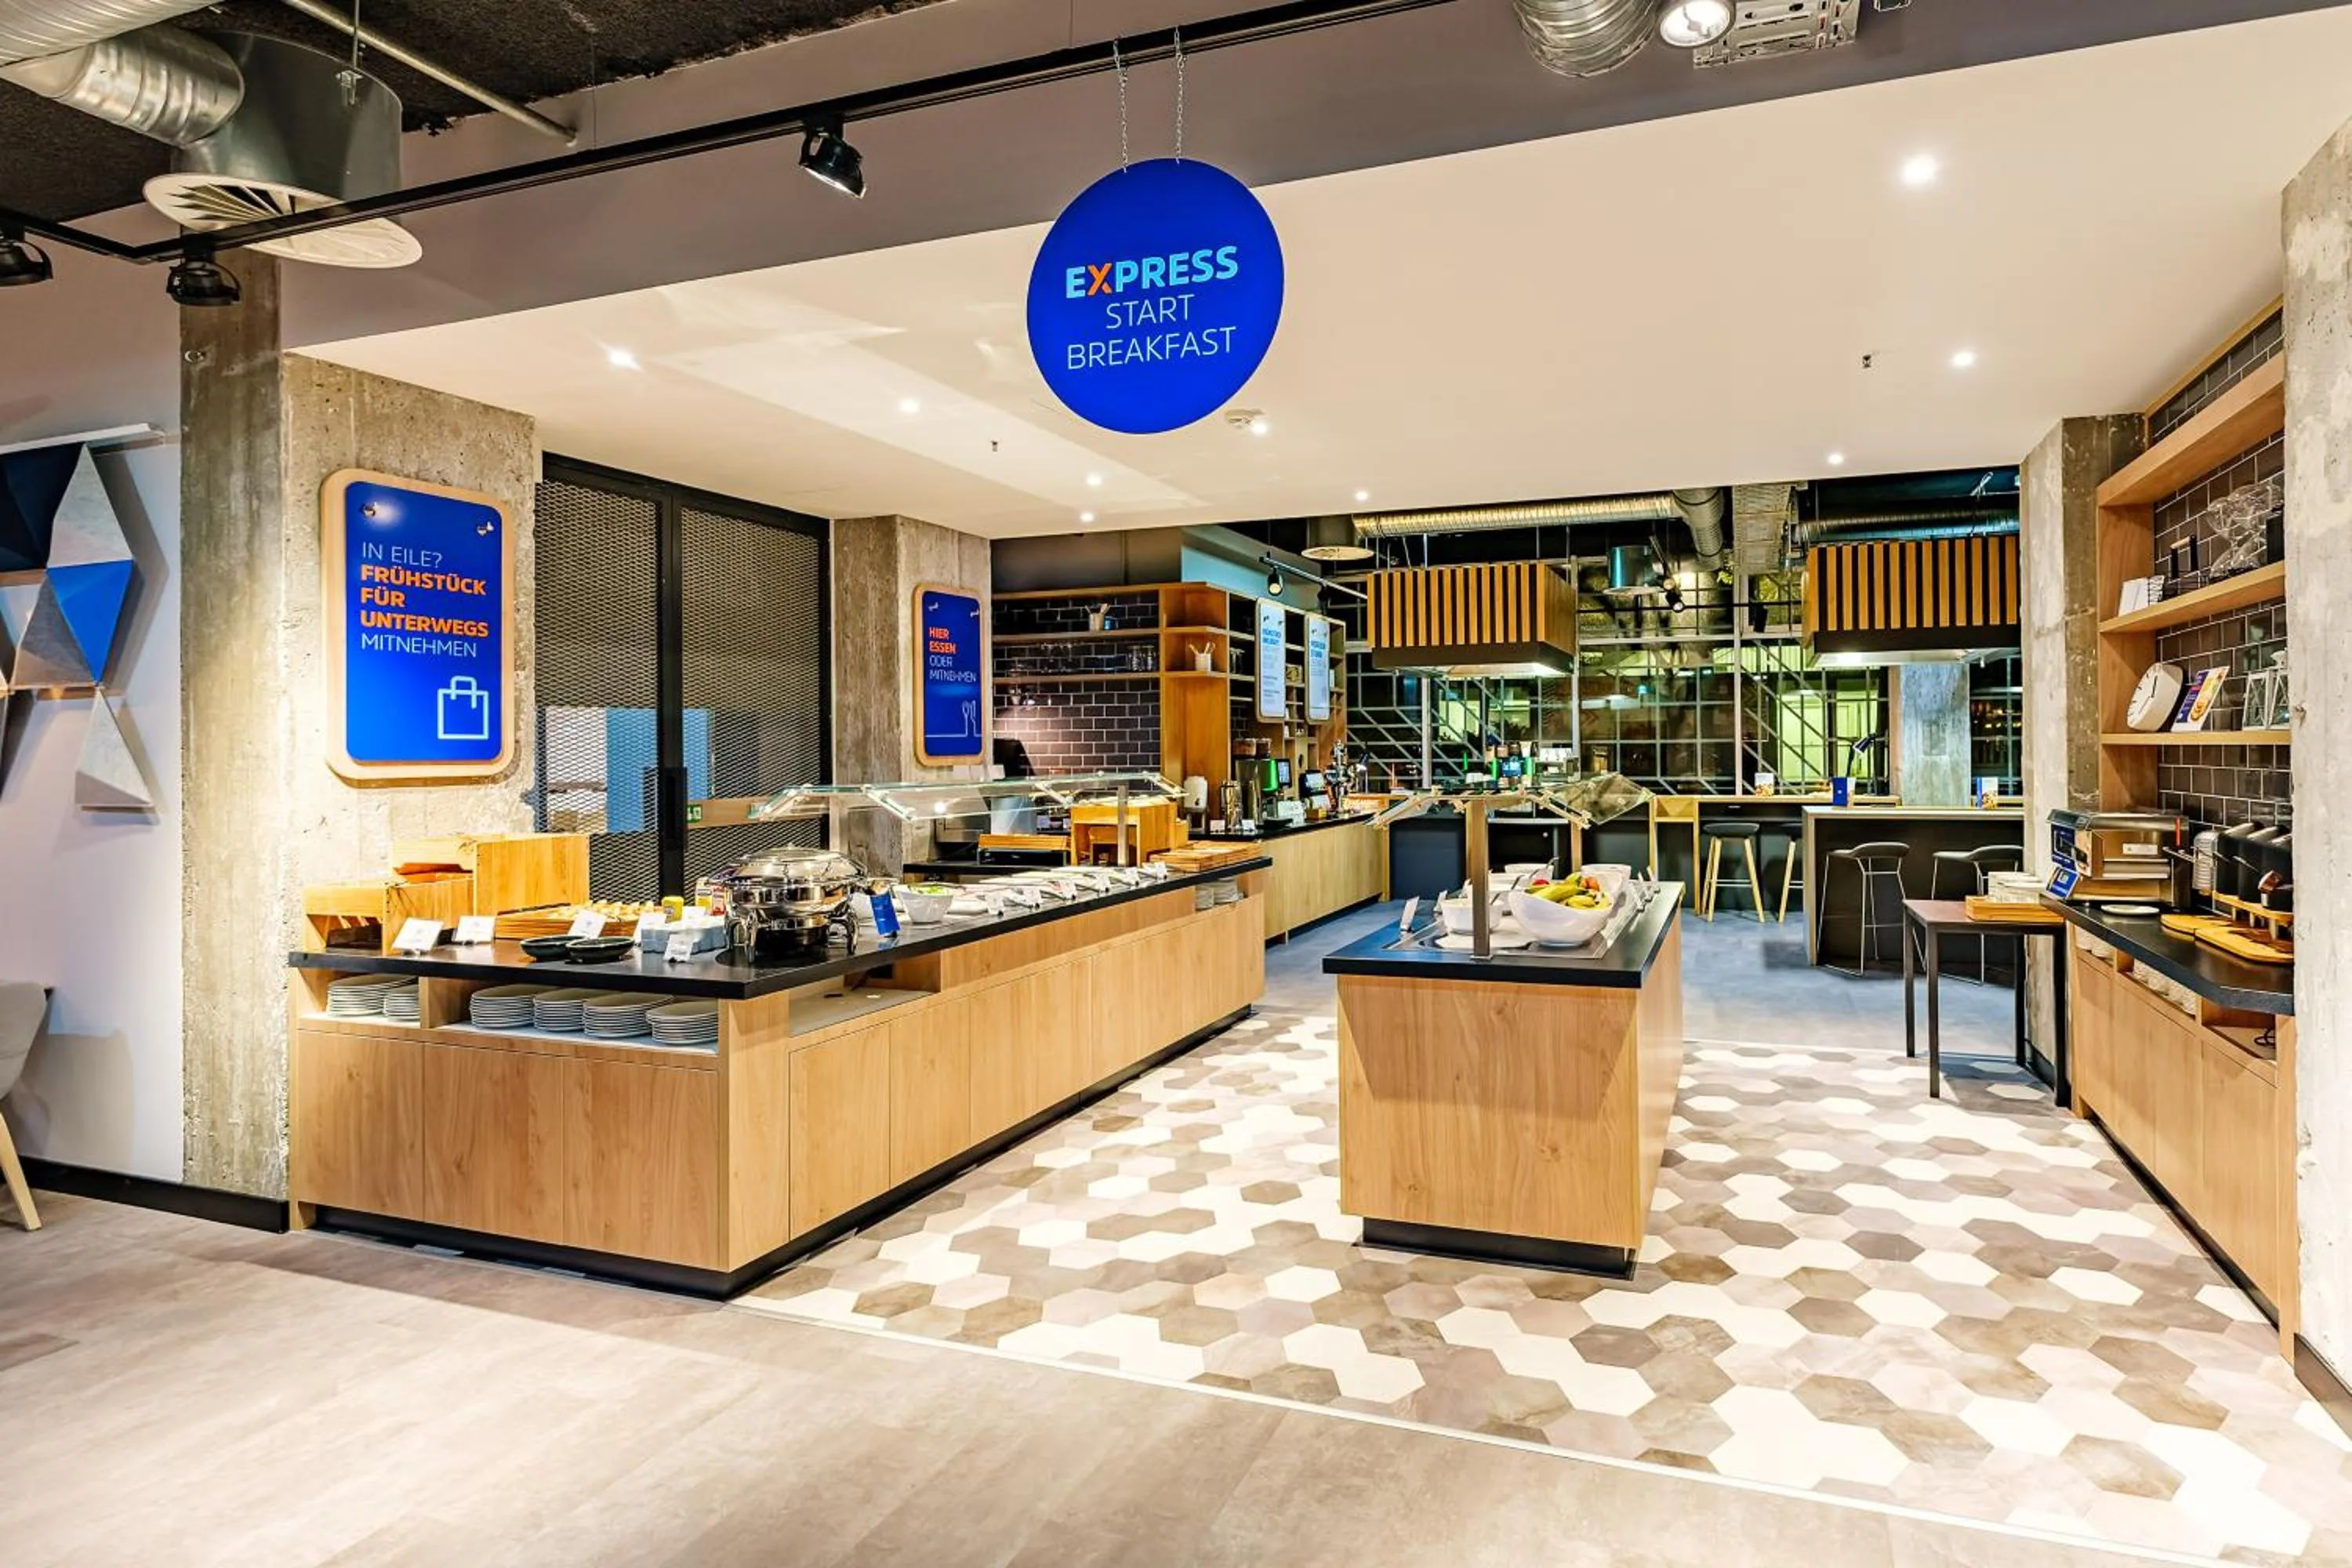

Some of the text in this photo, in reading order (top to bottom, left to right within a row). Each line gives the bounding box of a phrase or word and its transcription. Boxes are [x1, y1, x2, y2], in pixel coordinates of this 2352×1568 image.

[1066, 245, 1239, 299] EXPRESS
[1105, 294, 1195, 329] START
[1067, 326, 1236, 370] BREAKFAST
[362, 542, 443, 568] IN EILE?
[360, 564, 487, 596] FRÜHSTÜCK
[360, 586, 405, 608] FÜR
[360, 610, 488, 637] UNTERWEGS
[929, 626, 949, 640] HIER
[361, 633, 477, 658] MITNEHMEN
[929, 641, 956, 655] ESSEN
[929, 655, 953, 667] ODER
